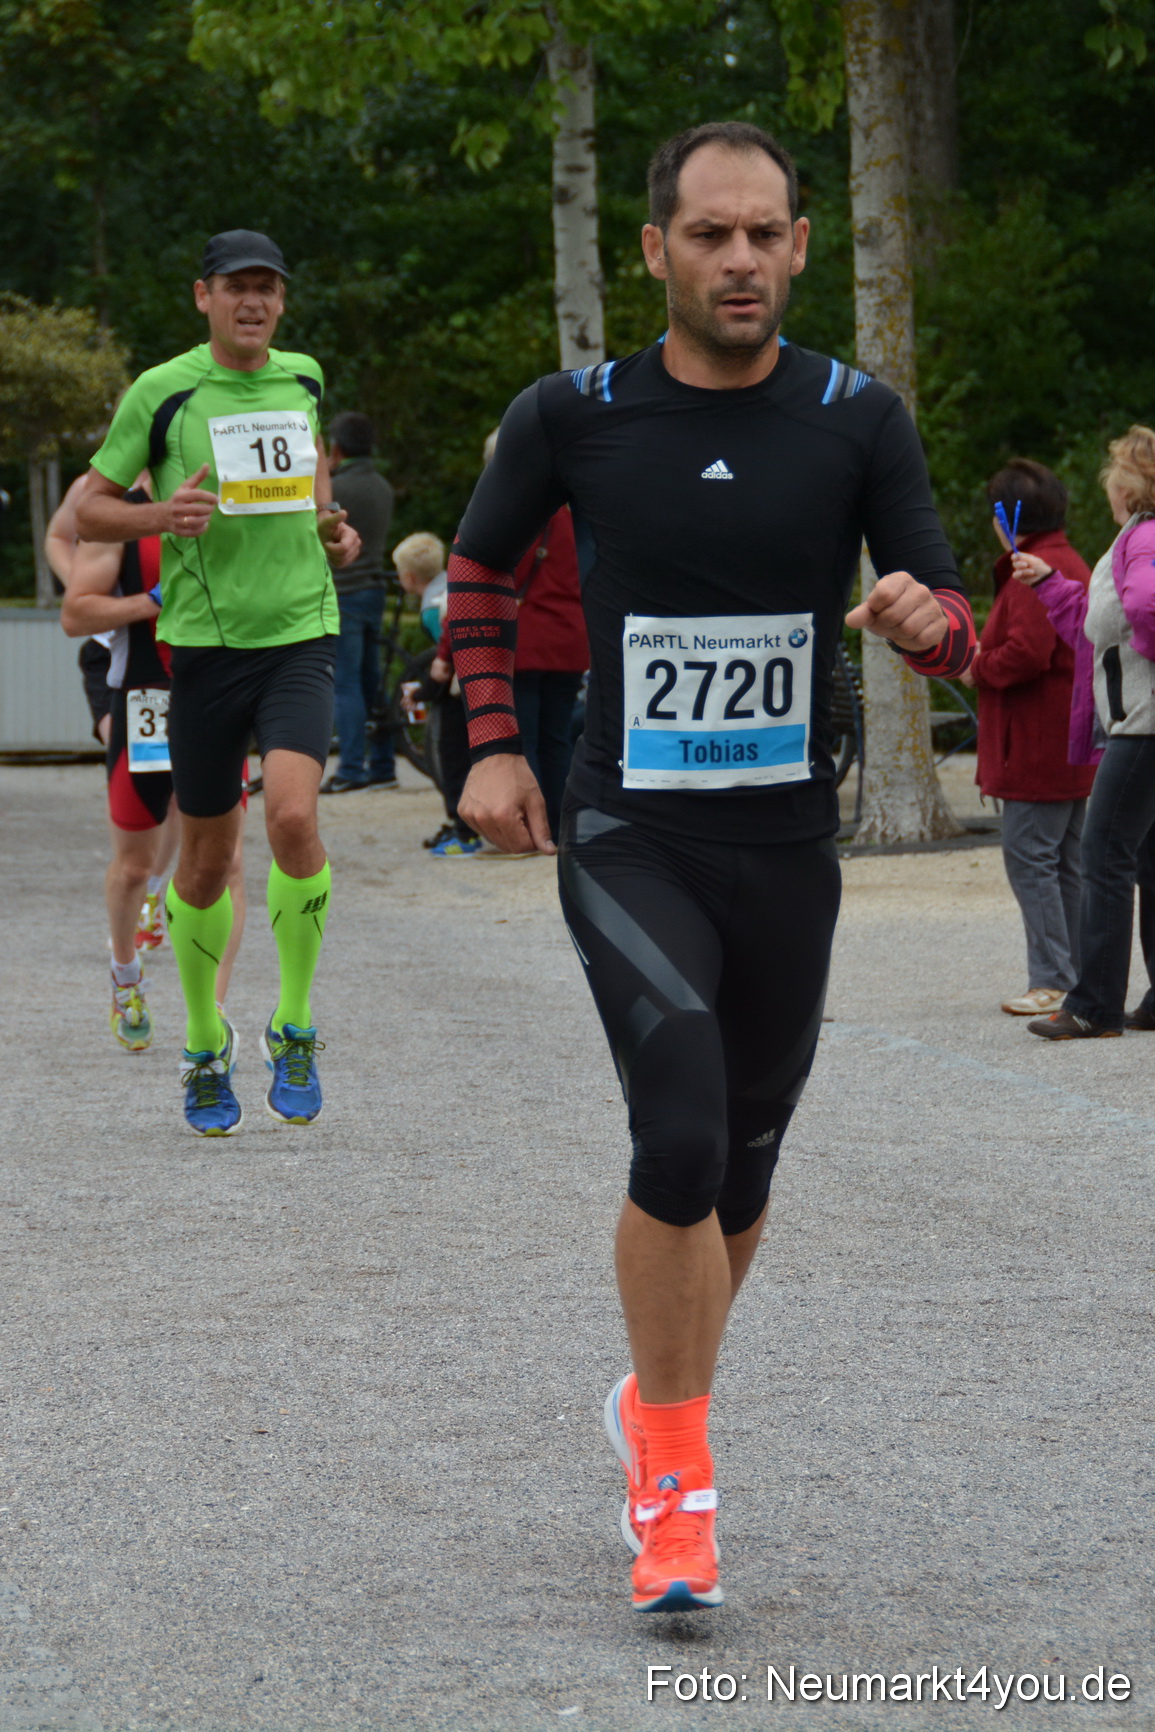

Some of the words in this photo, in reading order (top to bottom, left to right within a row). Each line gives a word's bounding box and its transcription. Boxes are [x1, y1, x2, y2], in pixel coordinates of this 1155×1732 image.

[252, 422, 297, 431] Neumarkt
[249, 436, 291, 473] 18
[701, 471, 733, 480] adidas
[247, 485, 297, 499] Thomas
[629, 633, 688, 650] PARTL
[693, 634, 781, 650] Neumarkt
[645, 657, 793, 721] 2720
[130, 695, 159, 705] PARTL
[679, 739, 758, 764] Tobias
